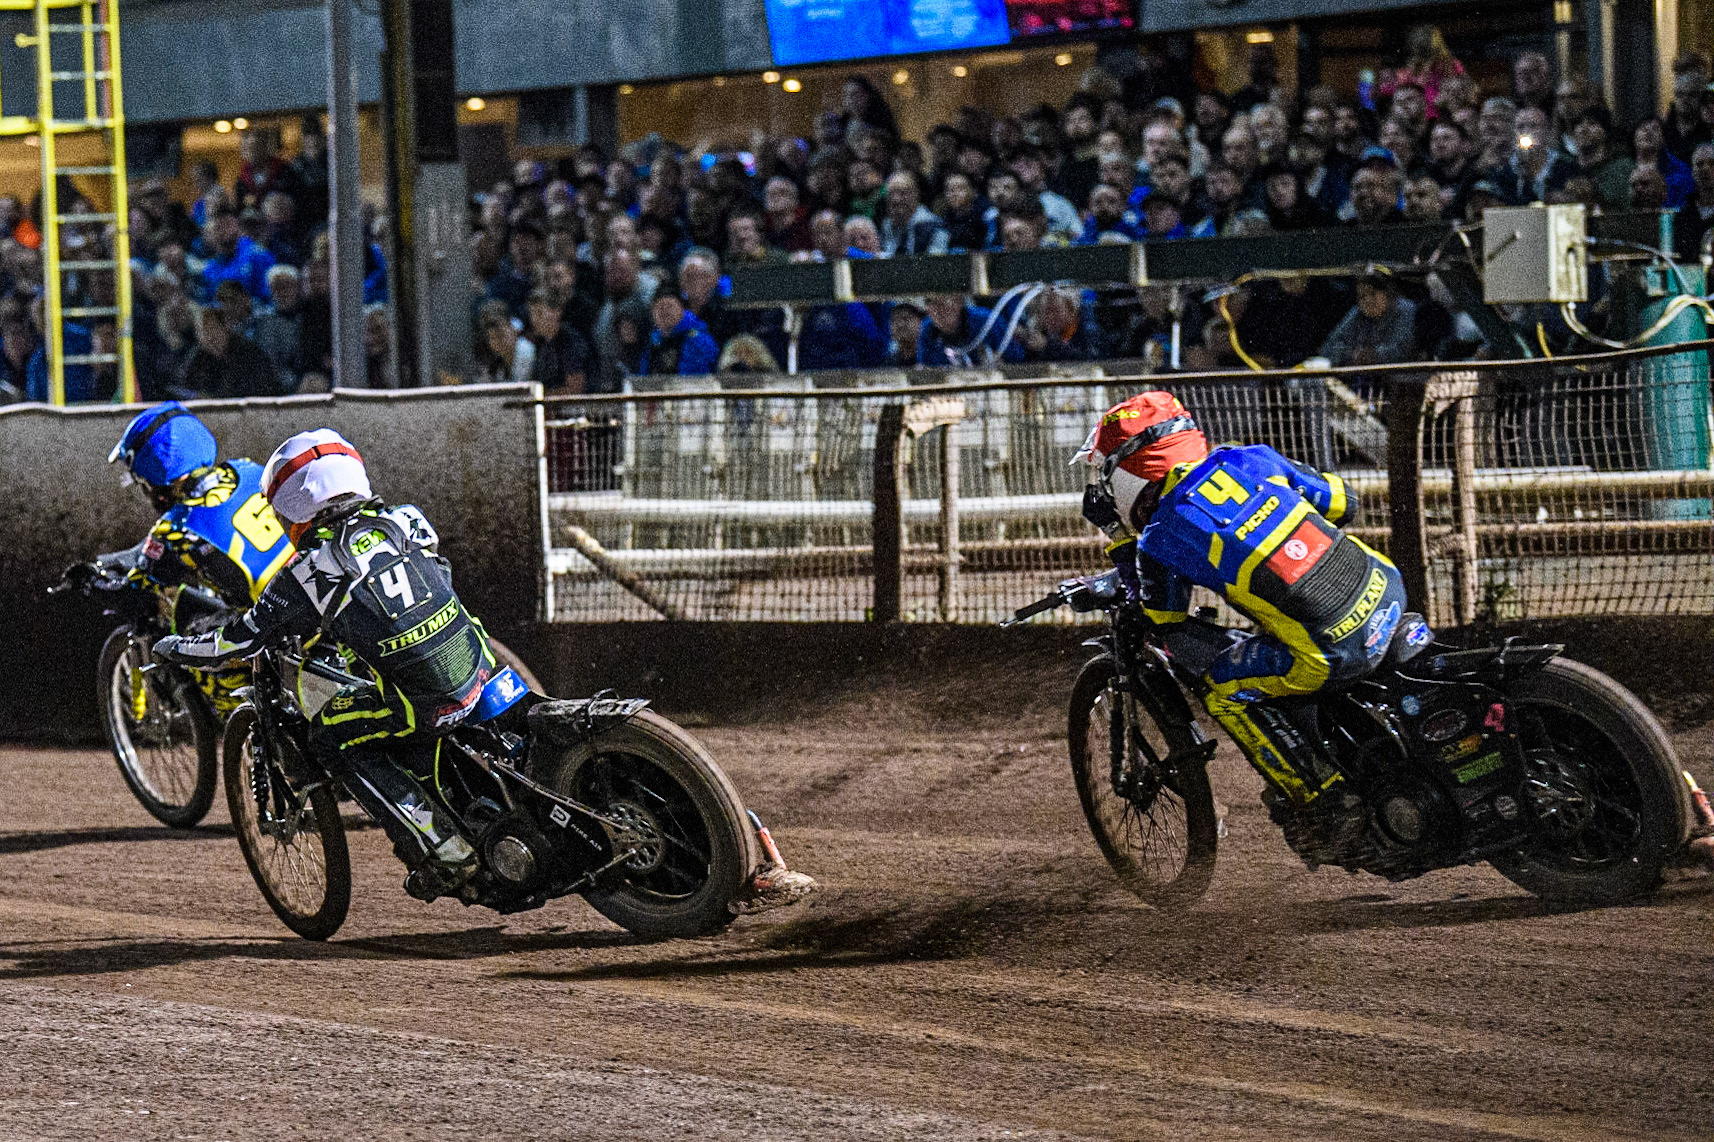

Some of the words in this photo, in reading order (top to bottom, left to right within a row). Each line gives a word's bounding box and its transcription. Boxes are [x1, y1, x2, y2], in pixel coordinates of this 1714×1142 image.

[1196, 468, 1251, 506] 4
[231, 491, 285, 553] 6
[379, 562, 416, 609] 4
[1484, 703, 1505, 732] 4
